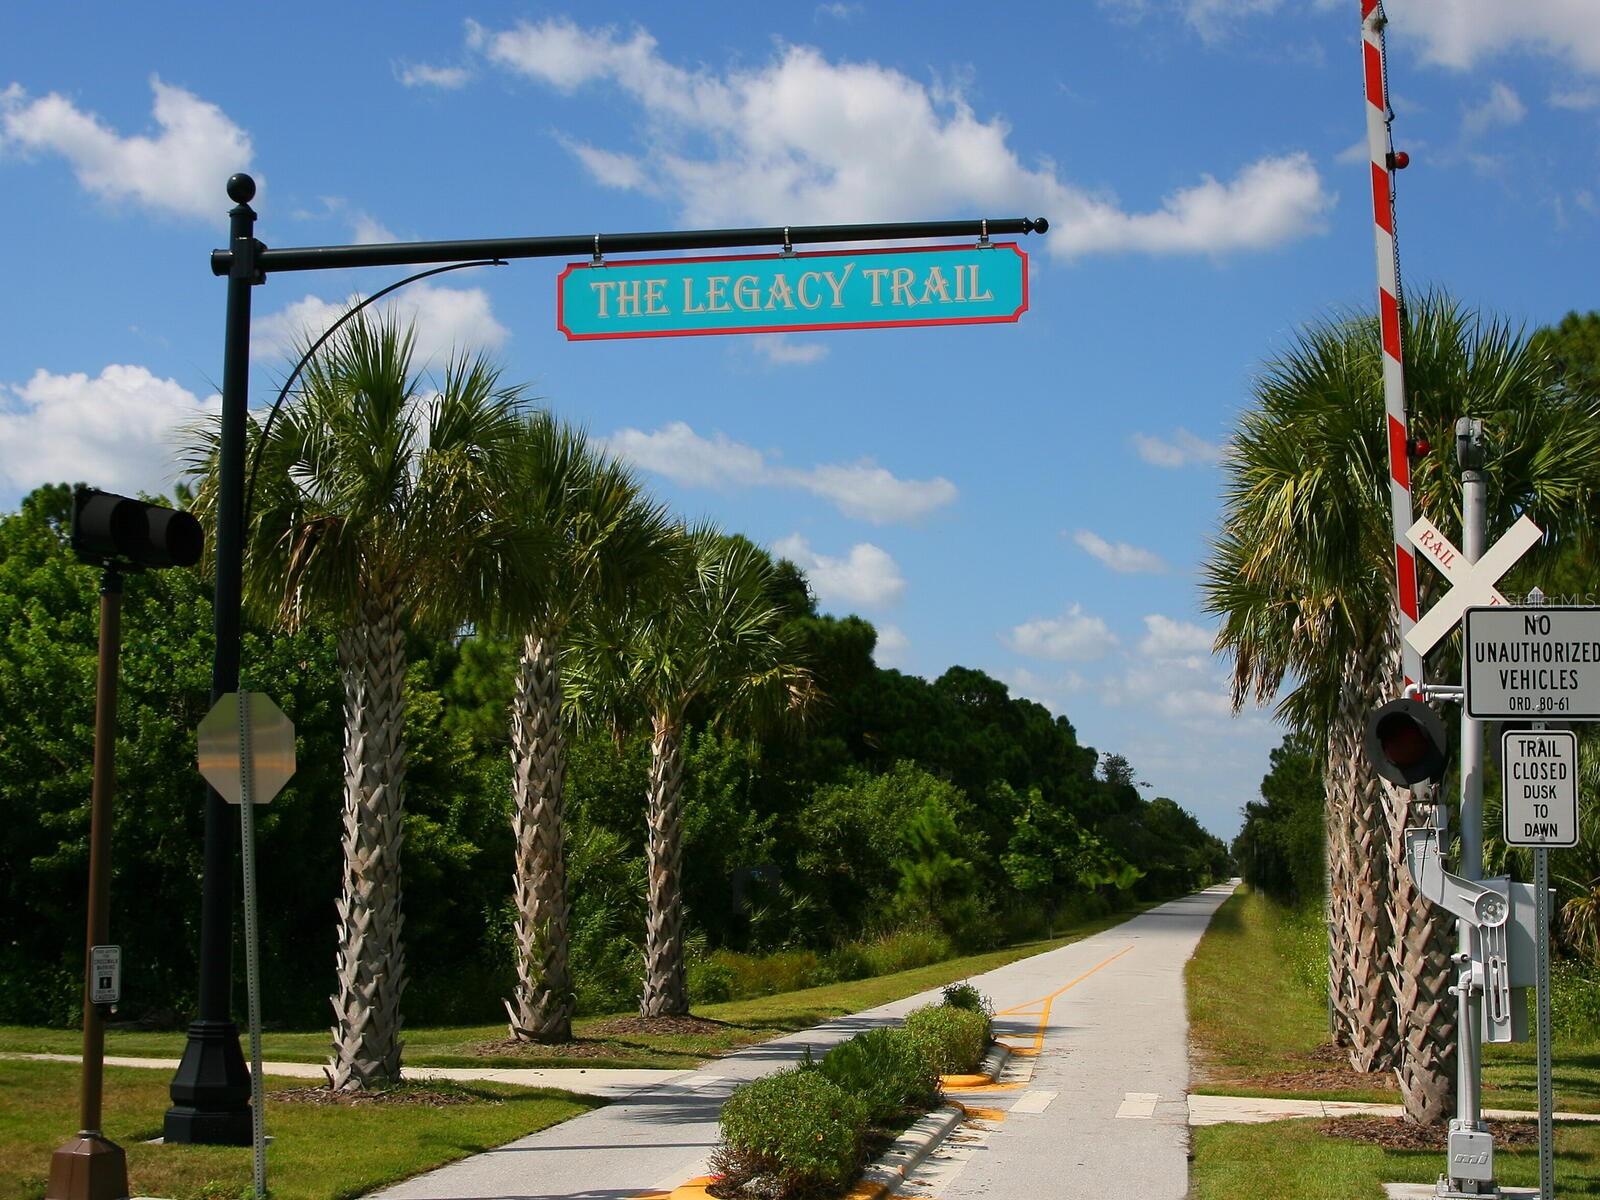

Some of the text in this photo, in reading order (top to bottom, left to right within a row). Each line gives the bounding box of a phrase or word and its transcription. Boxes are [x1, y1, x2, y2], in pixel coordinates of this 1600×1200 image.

[589, 262, 995, 319] THE LEGACY TRAIL
[1419, 529, 1458, 570] RAIL
[1524, 615, 1551, 635] NO
[1475, 642, 1600, 663] UNAUTHORIZED
[1499, 669, 1579, 690] VEHICLES
[1509, 696, 1569, 711] ORD. 80-61
[1518, 740, 1562, 757] TRAIL
[1513, 762, 1567, 780] CLOSED
[1523, 785, 1557, 799] DUSK
[1533, 804, 1549, 818] TO
[1525, 823, 1558, 837] DAWN
